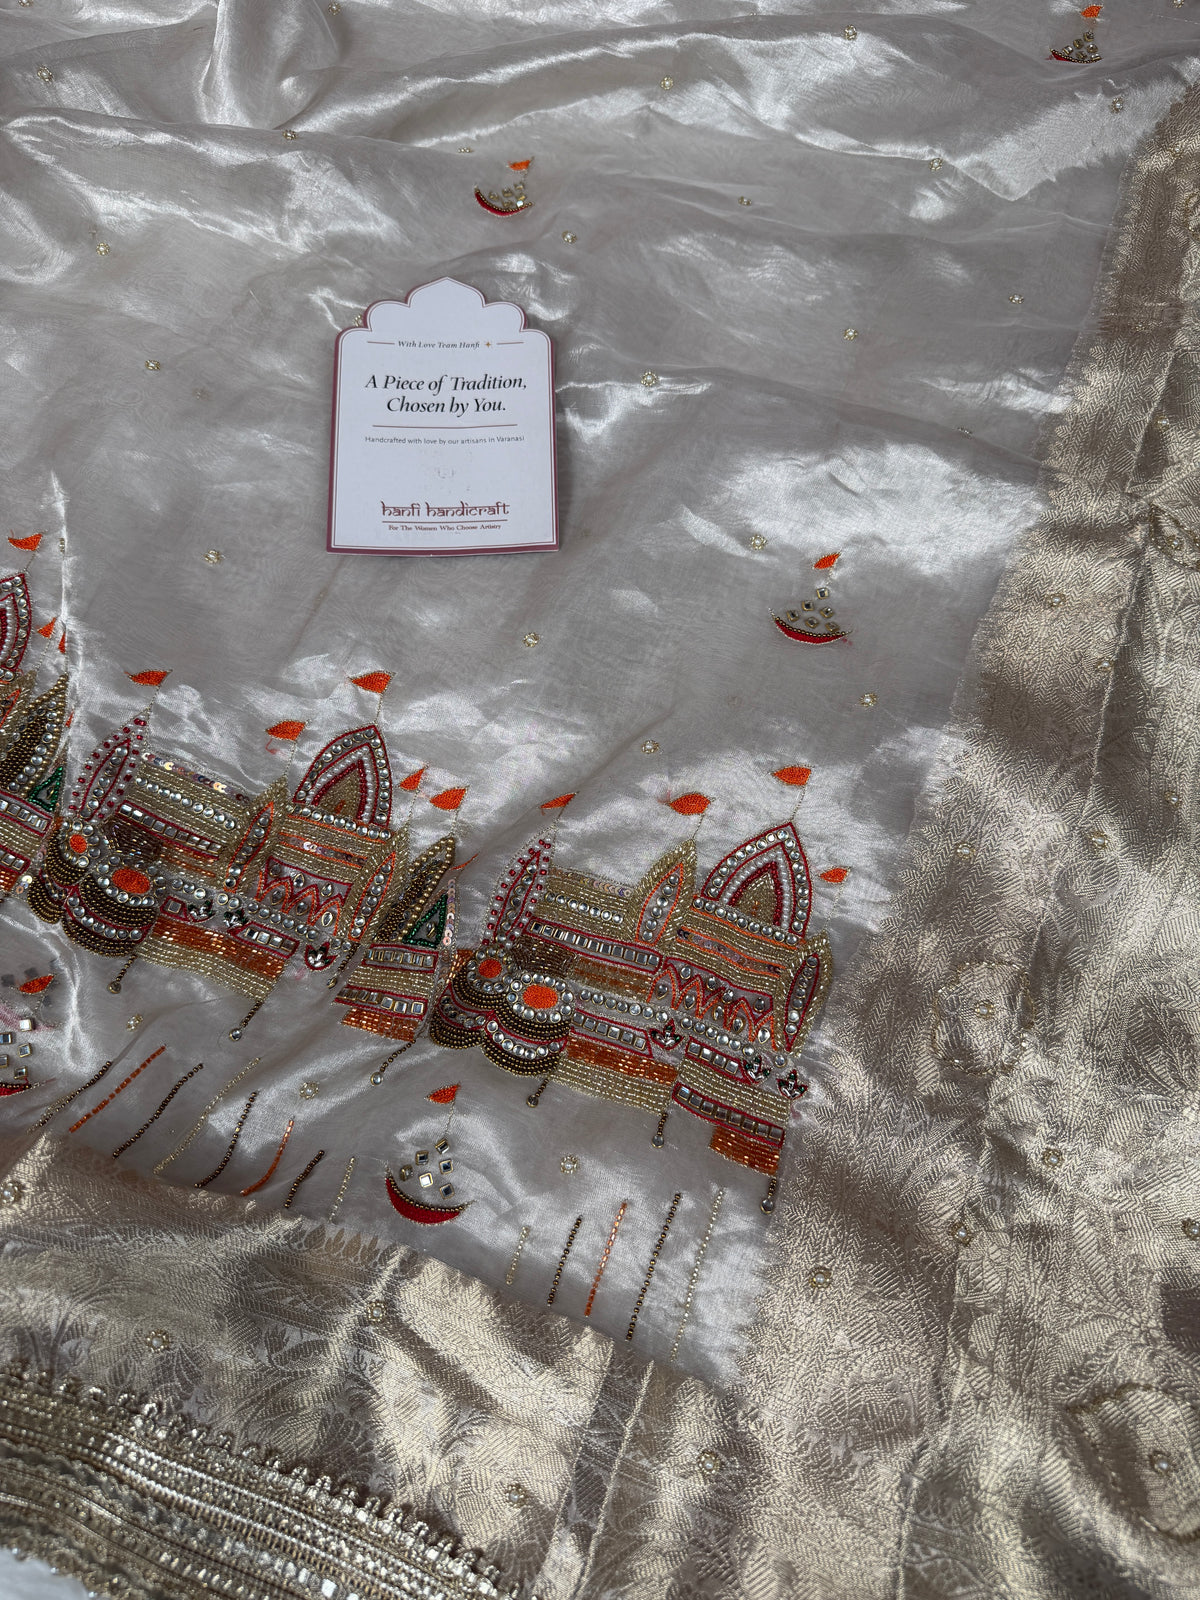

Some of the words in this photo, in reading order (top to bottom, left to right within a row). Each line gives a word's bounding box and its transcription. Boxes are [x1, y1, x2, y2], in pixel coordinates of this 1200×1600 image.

[365, 374, 378, 388] A
[384, 374, 424, 390] Piece
[428, 374, 448, 396] of
[450, 374, 527, 391] Tradition,
[386, 396, 445, 413] Chosen
[450, 397, 469, 417] by
[474, 398, 506, 412] You.
[365, 436, 406, 444] Handcrafted
[439, 438, 446, 446] by
[380, 500, 421, 517] hanfi
[425, 501, 510, 517] handicraft
